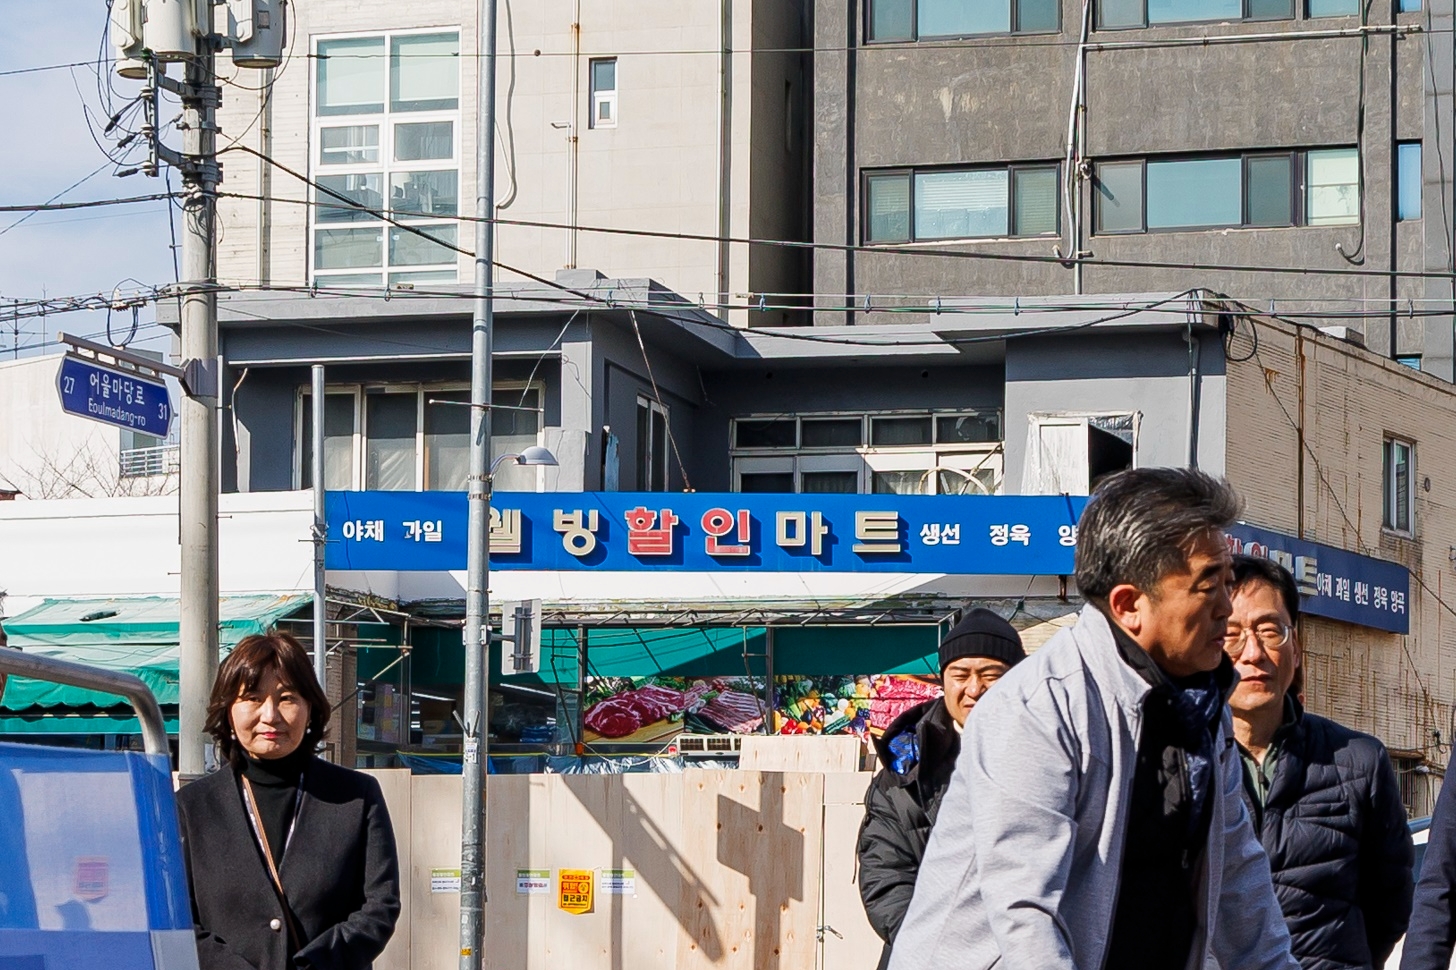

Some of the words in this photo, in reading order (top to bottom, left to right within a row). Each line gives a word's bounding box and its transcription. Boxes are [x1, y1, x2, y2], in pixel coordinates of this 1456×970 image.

[63, 376, 75, 394] 27
[89, 371, 145, 405] 어울마당로
[88, 398, 146, 427] Eoulmadang-ro
[158, 403, 168, 421] 31
[342, 520, 384, 542] 야채
[920, 523, 960, 546] 생선
[989, 524, 1031, 546] 정육
[1316, 572, 1332, 598] 야채
[1335, 577, 1350, 602] 과일
[1354, 581, 1369, 605] 생선
[1373, 586, 1388, 611] 정육
[1390, 590, 1405, 615] 양곡
